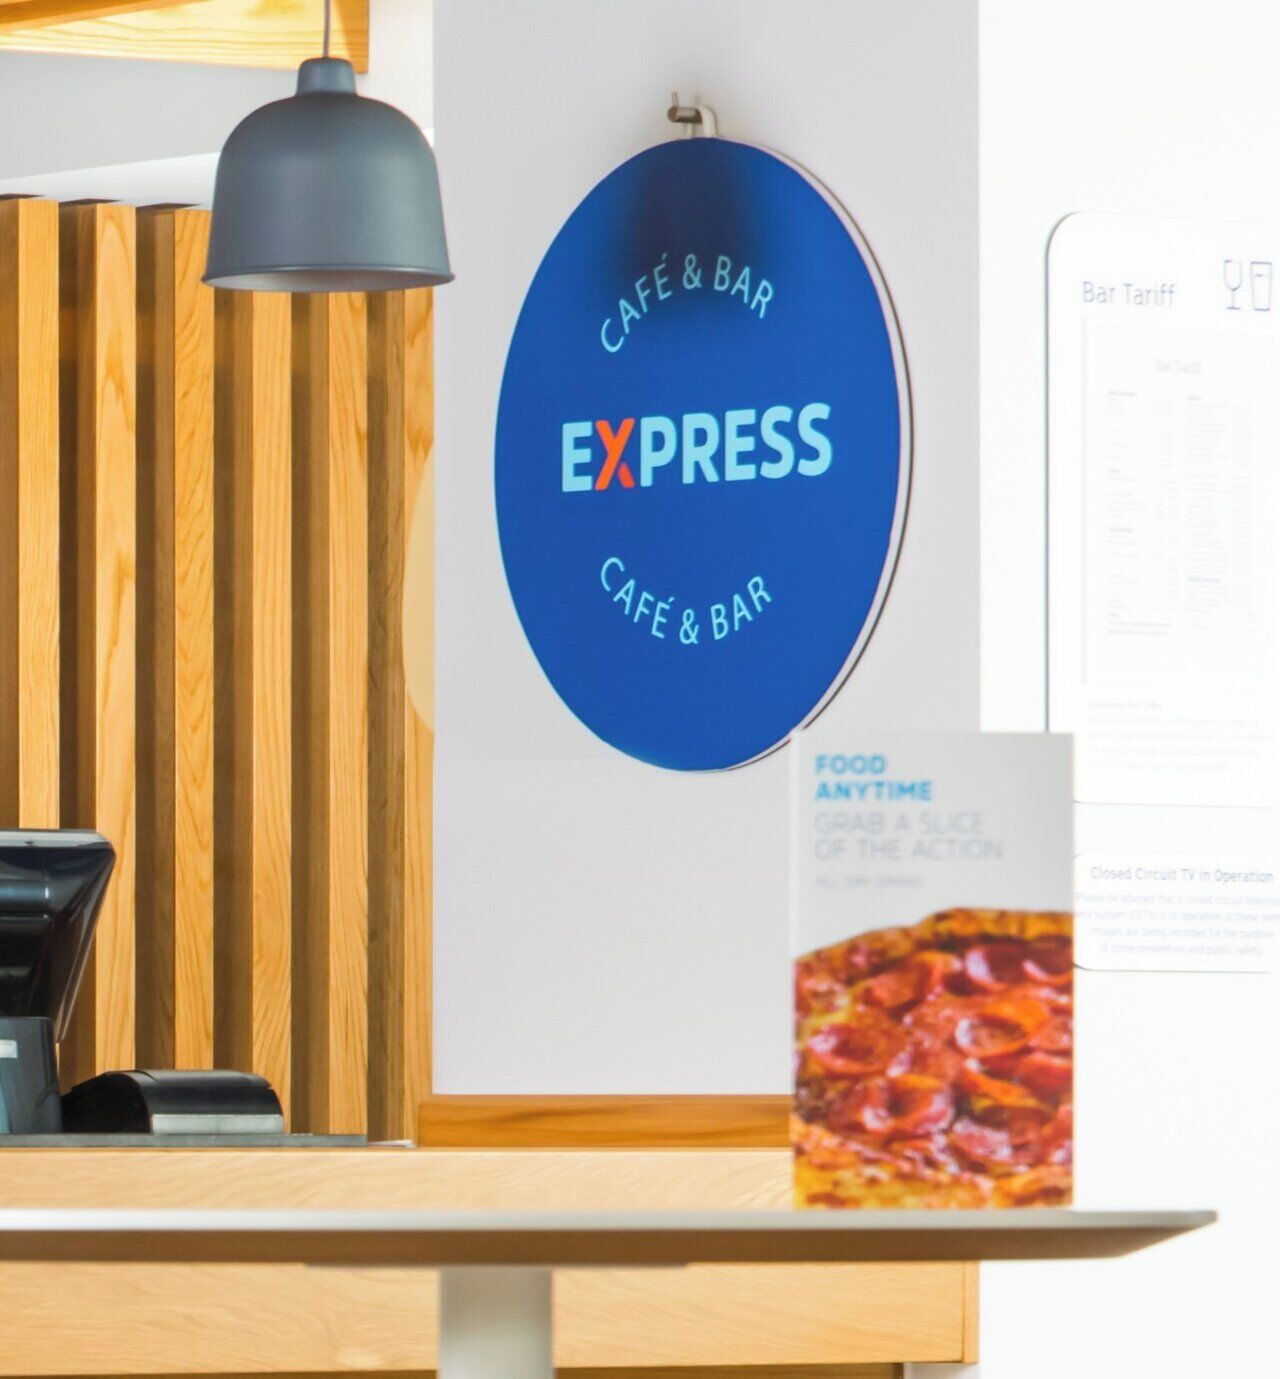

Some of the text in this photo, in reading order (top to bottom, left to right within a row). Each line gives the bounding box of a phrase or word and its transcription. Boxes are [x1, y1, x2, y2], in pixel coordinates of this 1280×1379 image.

[600, 252, 775, 353] CAFÉ & BAR
[1081, 280, 1176, 308] Bar Tariff
[562, 402, 833, 493] EXPRESS
[600, 556, 773, 645] CAFÉ & BAR
[815, 753, 888, 776] FOOD
[815, 780, 933, 802] ANYTIME
[815, 811, 986, 836] GRAB A SLICE
[814, 839, 1006, 863] OF THE ACTION
[1090, 866, 1275, 885] Closed Circuit TV in Operation
